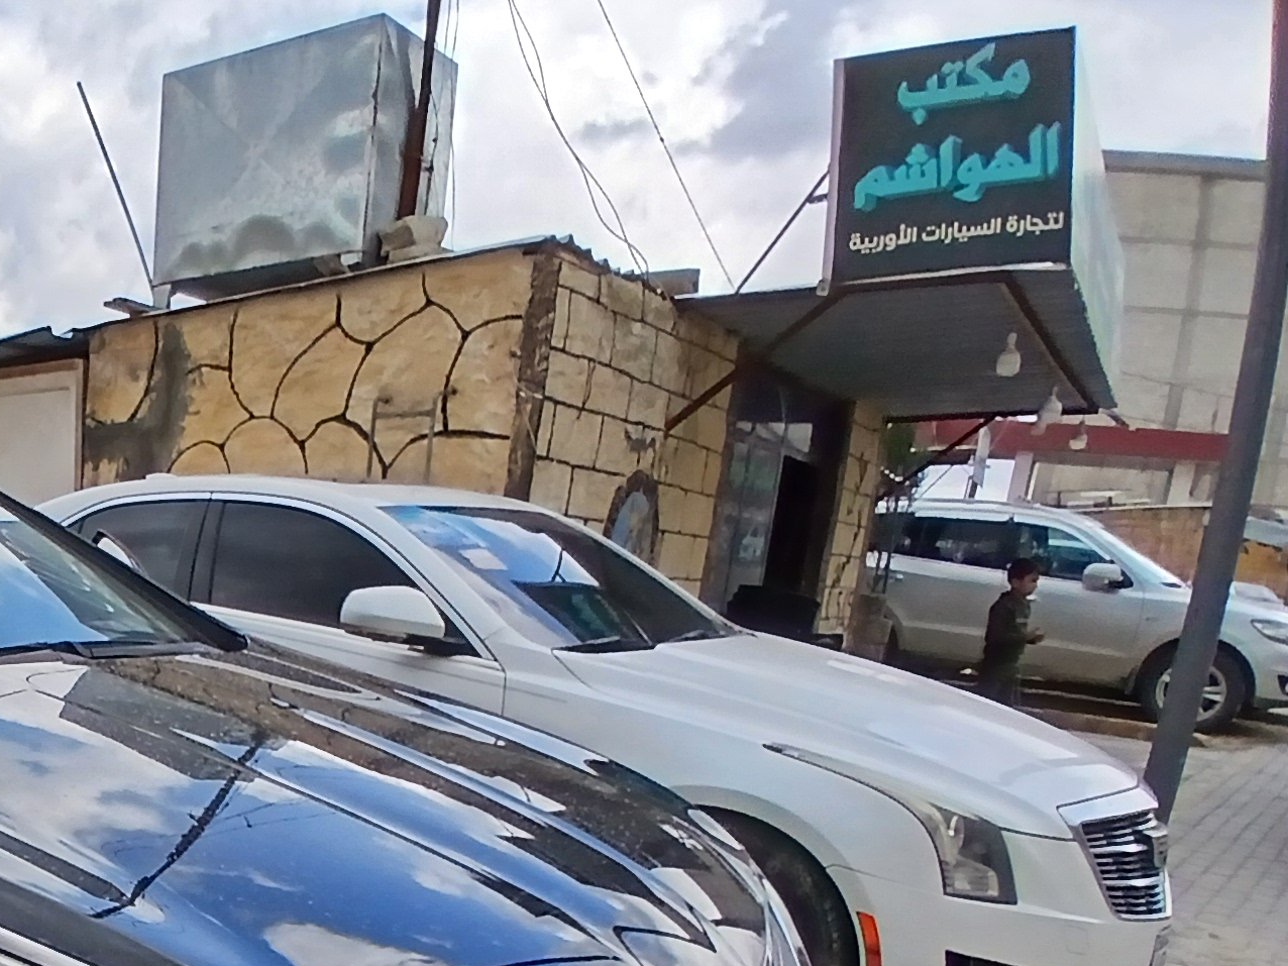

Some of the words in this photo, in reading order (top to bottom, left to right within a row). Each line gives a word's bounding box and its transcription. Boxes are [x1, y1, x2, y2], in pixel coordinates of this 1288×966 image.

[897, 42, 1031, 125] مكتب
[854, 121, 1062, 211] الهواشم
[849, 224, 917, 254] الأوربية
[922, 217, 1001, 243] السيارات
[1006, 212, 1065, 236] لتجارة
